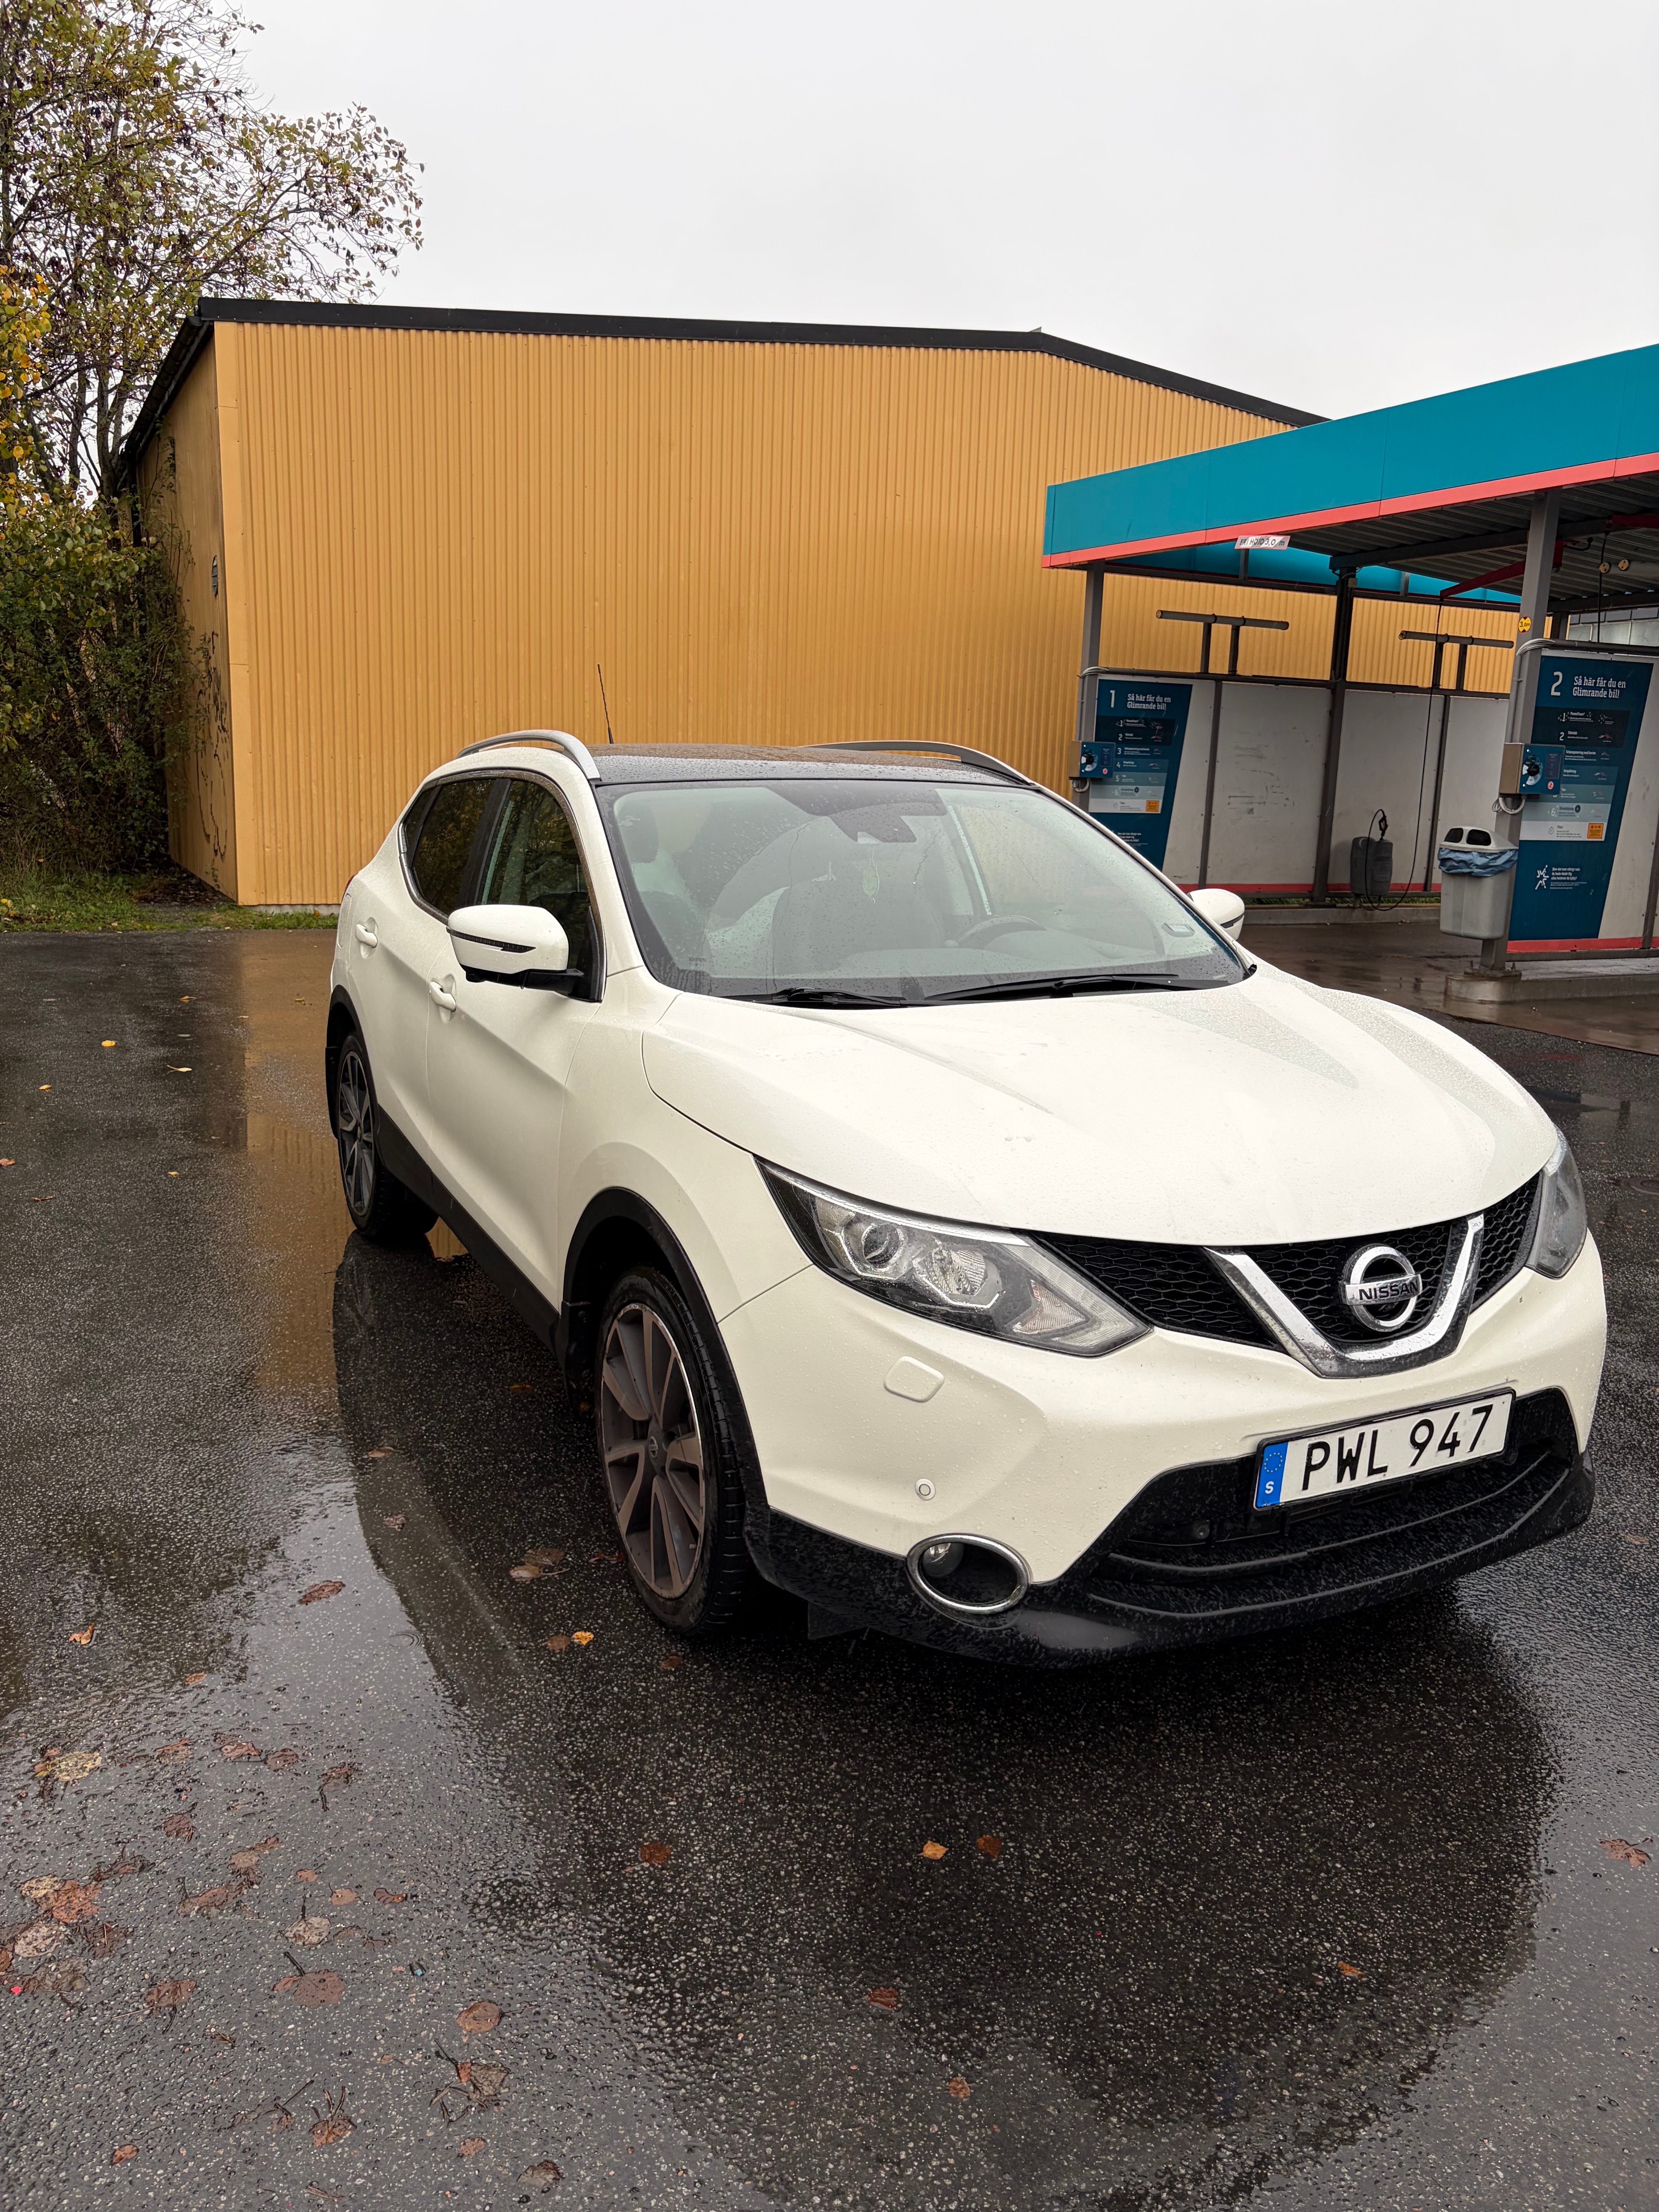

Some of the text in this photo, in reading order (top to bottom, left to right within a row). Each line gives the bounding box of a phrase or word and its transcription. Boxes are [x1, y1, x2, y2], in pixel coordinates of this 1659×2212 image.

[1249, 537, 1264, 545] HÖJD
[1551, 671, 1563, 696] 2
[1574, 675, 1582, 685] Så
[1583, 677, 1596, 686] här
[1596, 677, 1607, 687] får
[1608, 678, 1616, 688] du
[1573, 687, 1620, 698] Glimrande bil!
[1109, 690, 1115, 708] 1
[1127, 701, 1156, 710] Glimrande
[1563, 713, 1565, 721] 1
[1559, 732, 1565, 741] 2
[1551, 808, 1555, 817] 6
[1358, 1281, 1418, 1300] NISSAN
[1302, 1404, 1494, 1491] PWL 947
[1264, 1481, 1274, 1494] S
